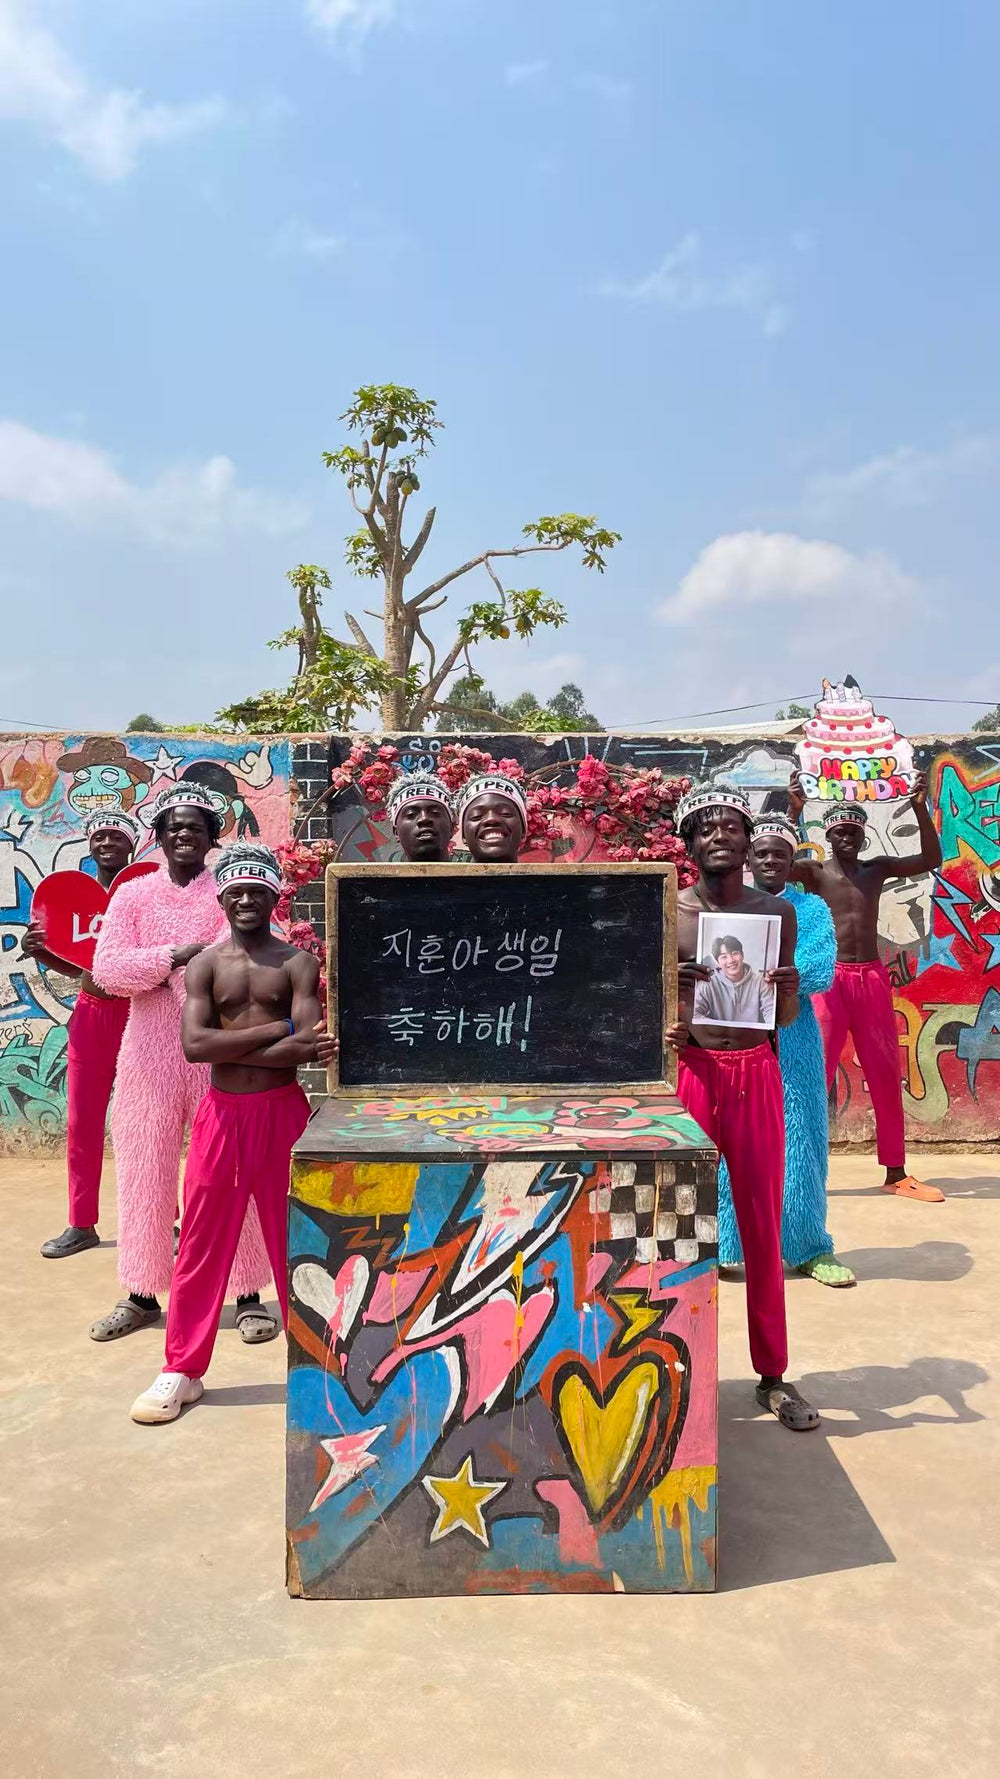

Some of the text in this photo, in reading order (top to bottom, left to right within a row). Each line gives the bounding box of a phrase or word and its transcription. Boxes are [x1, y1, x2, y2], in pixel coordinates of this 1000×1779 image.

[820, 756, 897, 780] HAPPY
[72, 912, 104, 943] LO
[382, 928, 563, 977] 지훈아 생일
[387, 995, 533, 1052] 축하해!
